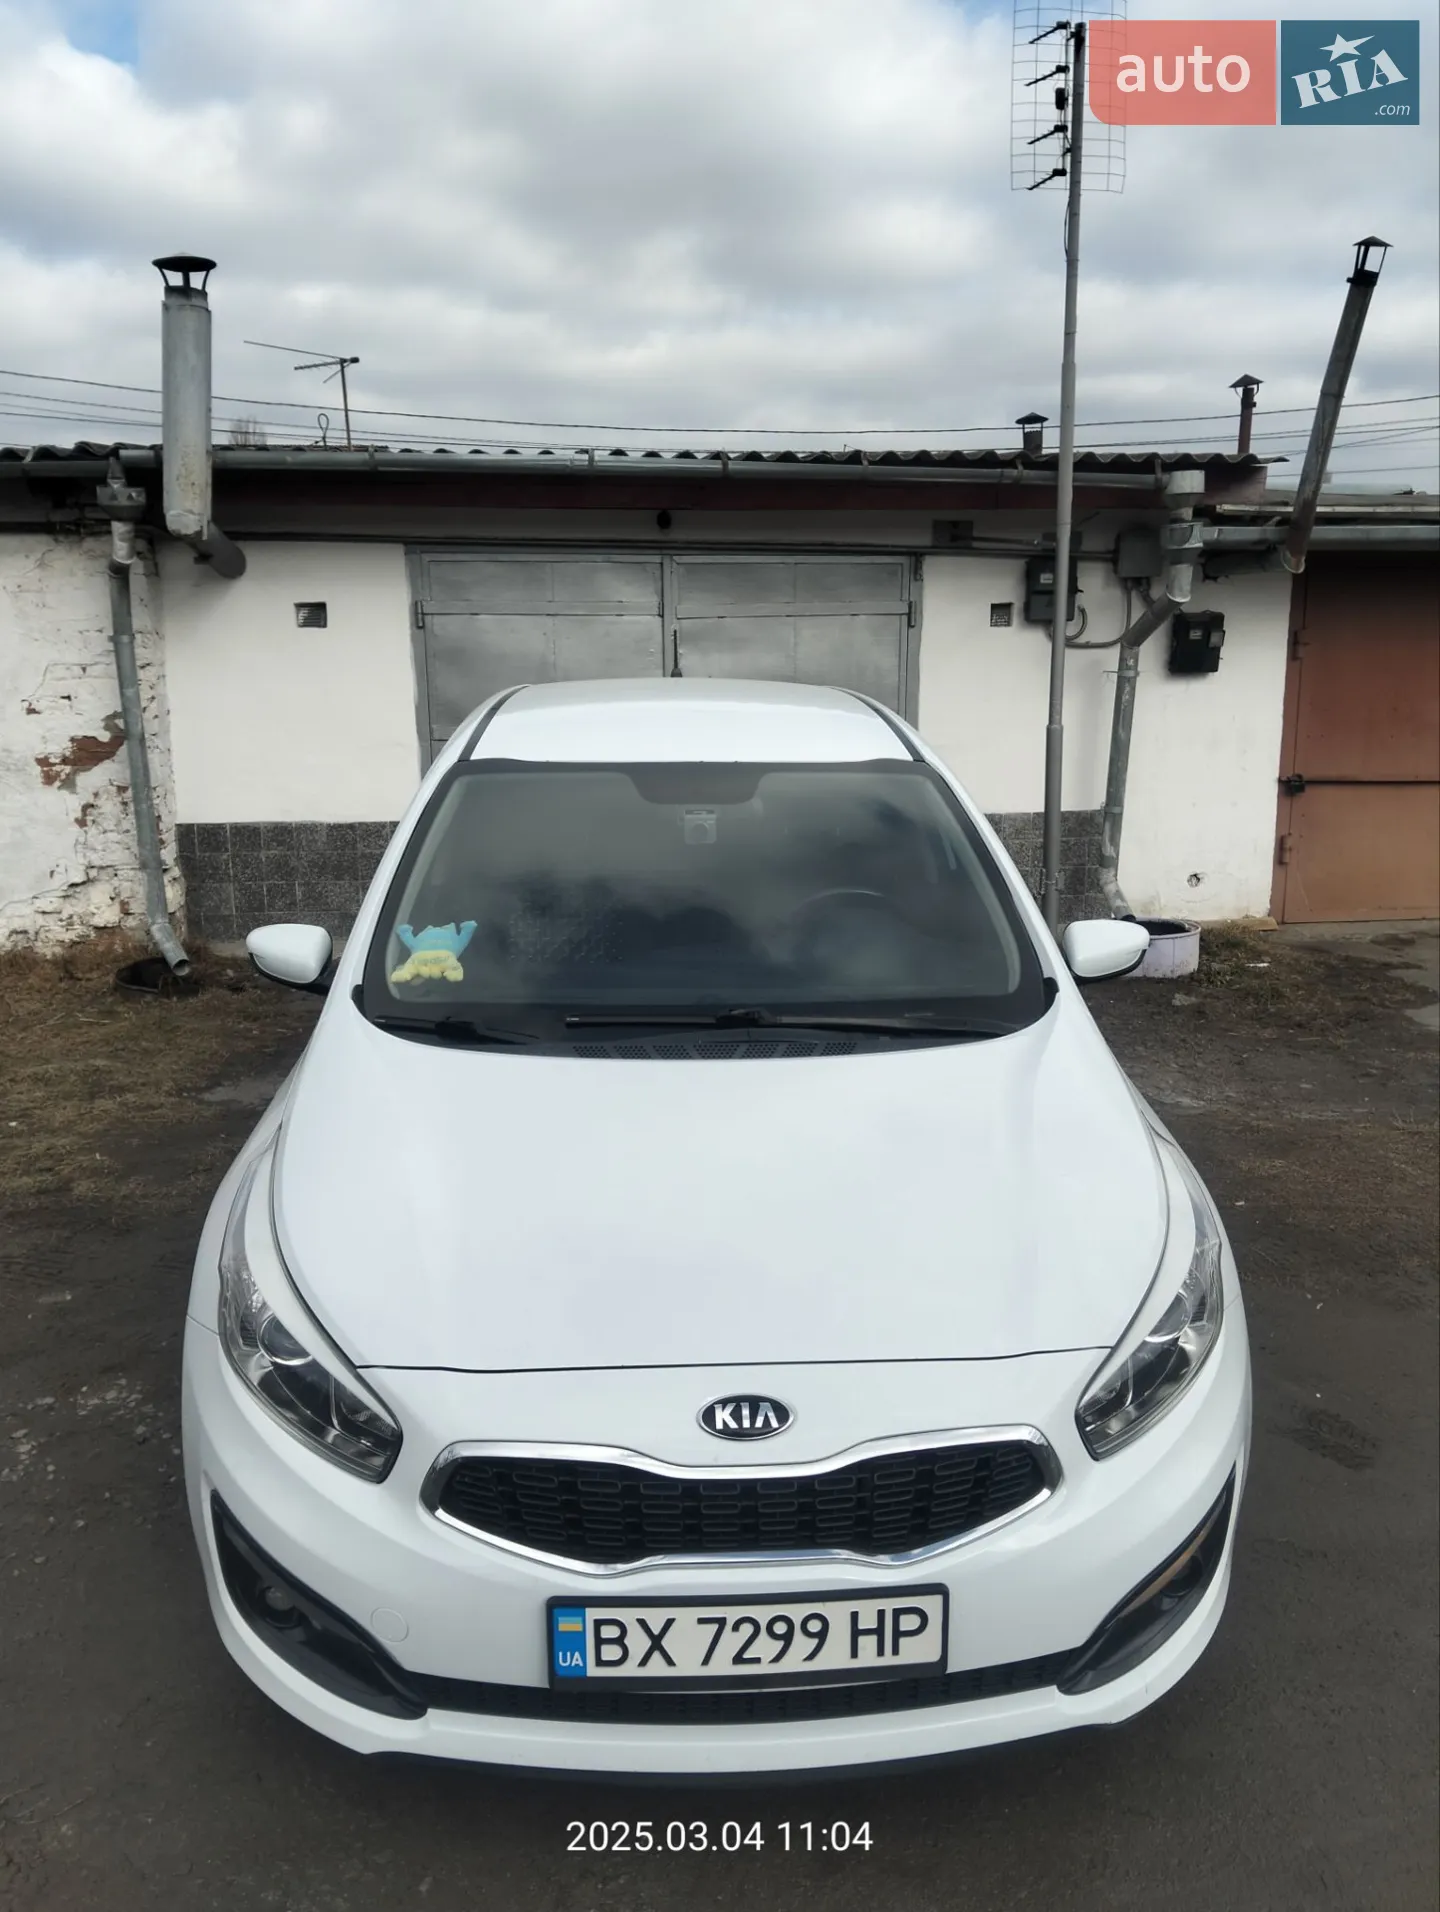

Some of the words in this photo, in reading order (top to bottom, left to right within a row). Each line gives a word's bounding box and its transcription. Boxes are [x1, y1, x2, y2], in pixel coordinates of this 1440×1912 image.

[713, 1402, 779, 1430] KIA
[593, 1617, 676, 1667] BX
[697, 1612, 830, 1666] 7299
[850, 1606, 929, 1659] HP
[558, 1651, 584, 1667] UA
